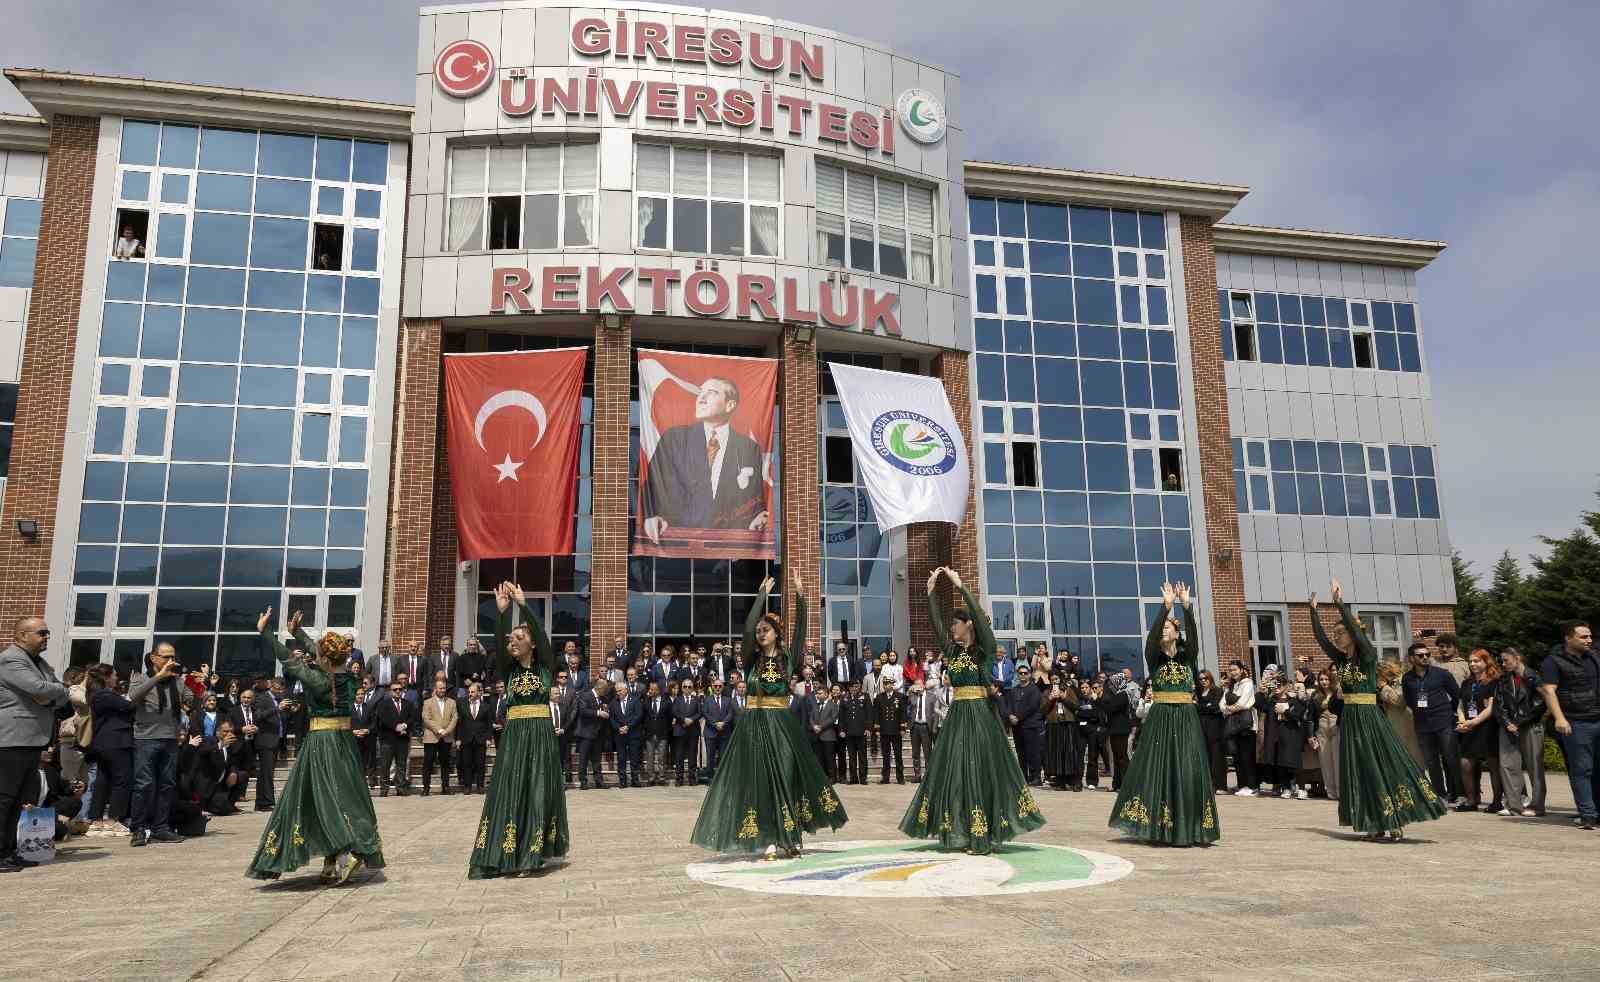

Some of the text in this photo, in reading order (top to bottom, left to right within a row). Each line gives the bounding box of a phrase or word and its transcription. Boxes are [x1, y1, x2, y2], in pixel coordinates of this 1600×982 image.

[571, 10, 825, 82] GİRESUN
[500, 67, 895, 155] ÜNİVERSİTESİ
[490, 259, 903, 336] REKTÖRLÜK
[909, 464, 943, 475] 2006
